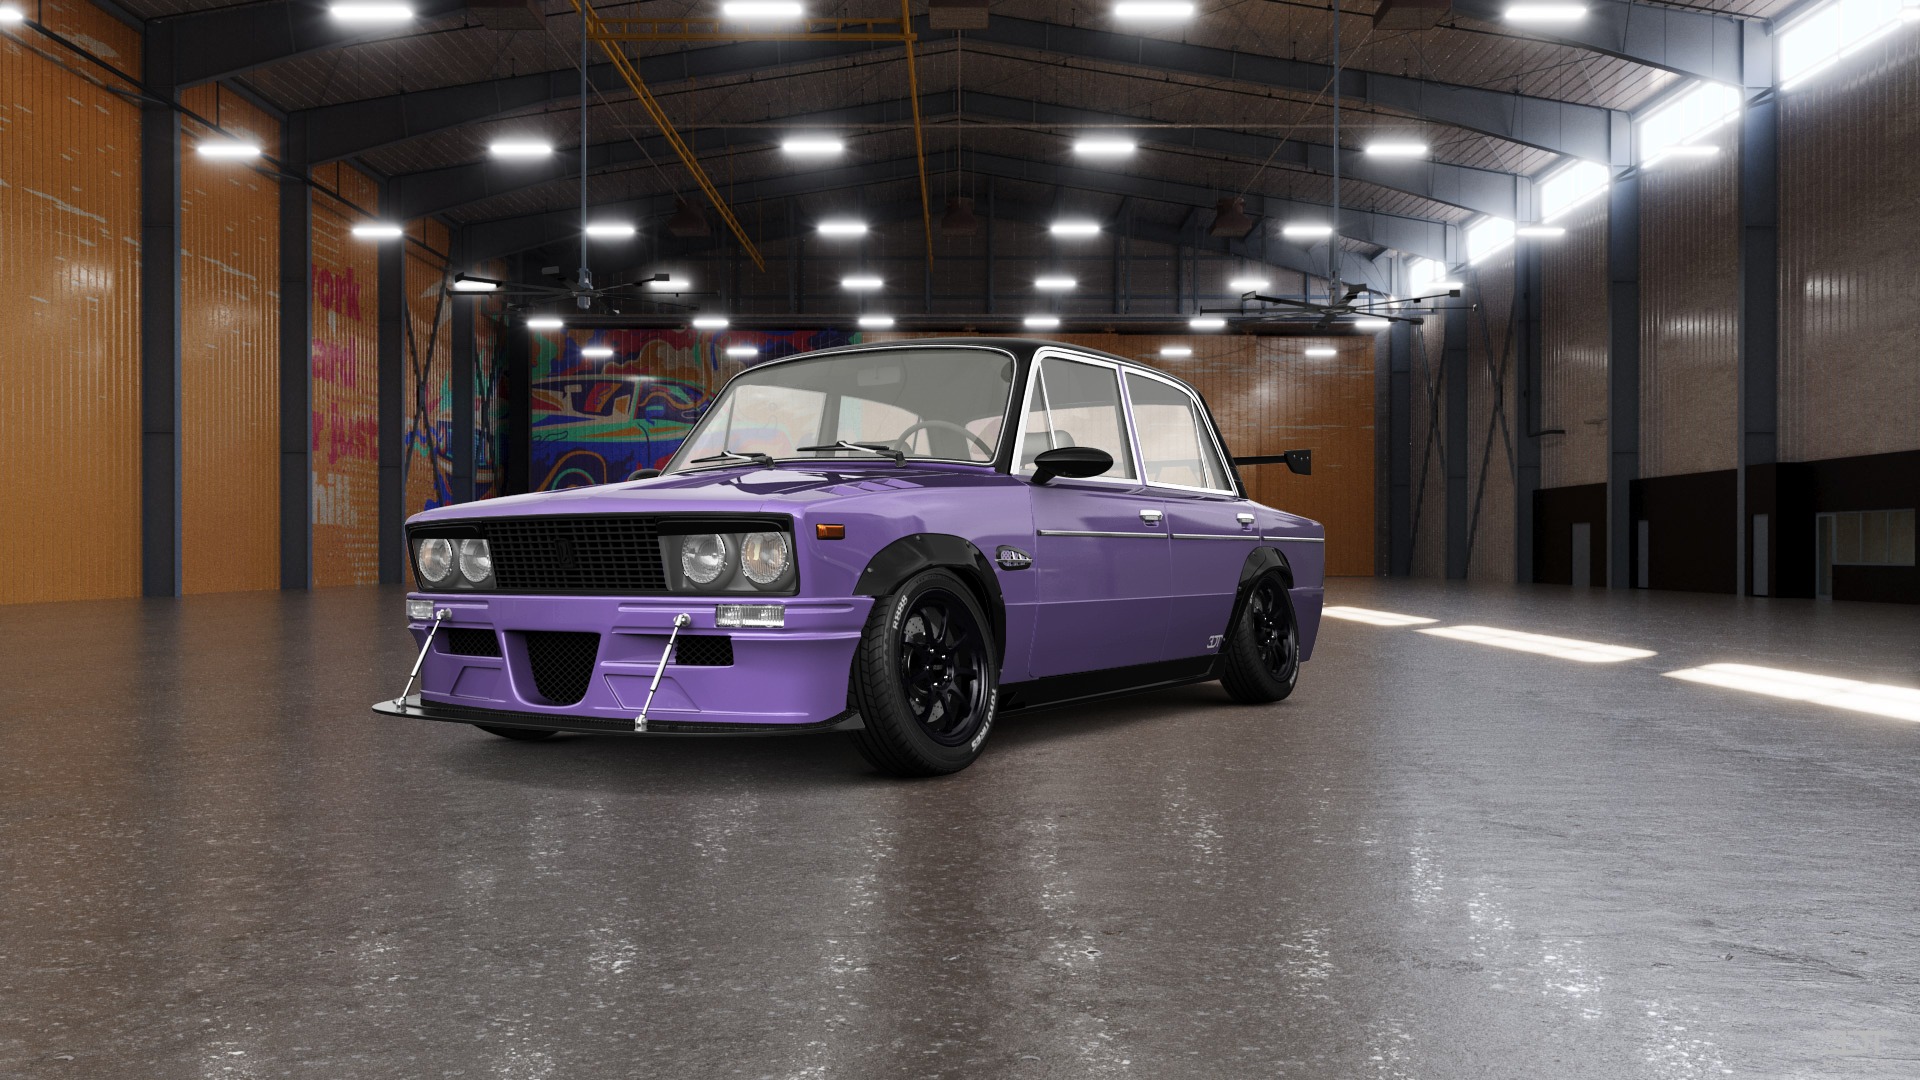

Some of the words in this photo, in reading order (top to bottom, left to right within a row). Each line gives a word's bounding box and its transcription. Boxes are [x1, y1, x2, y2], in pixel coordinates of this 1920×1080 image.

[312, 264, 362, 321] ork
[892, 594, 908, 630] R888
[987, 688, 997, 722] TOYO
[971, 720, 990, 752] TIRES
